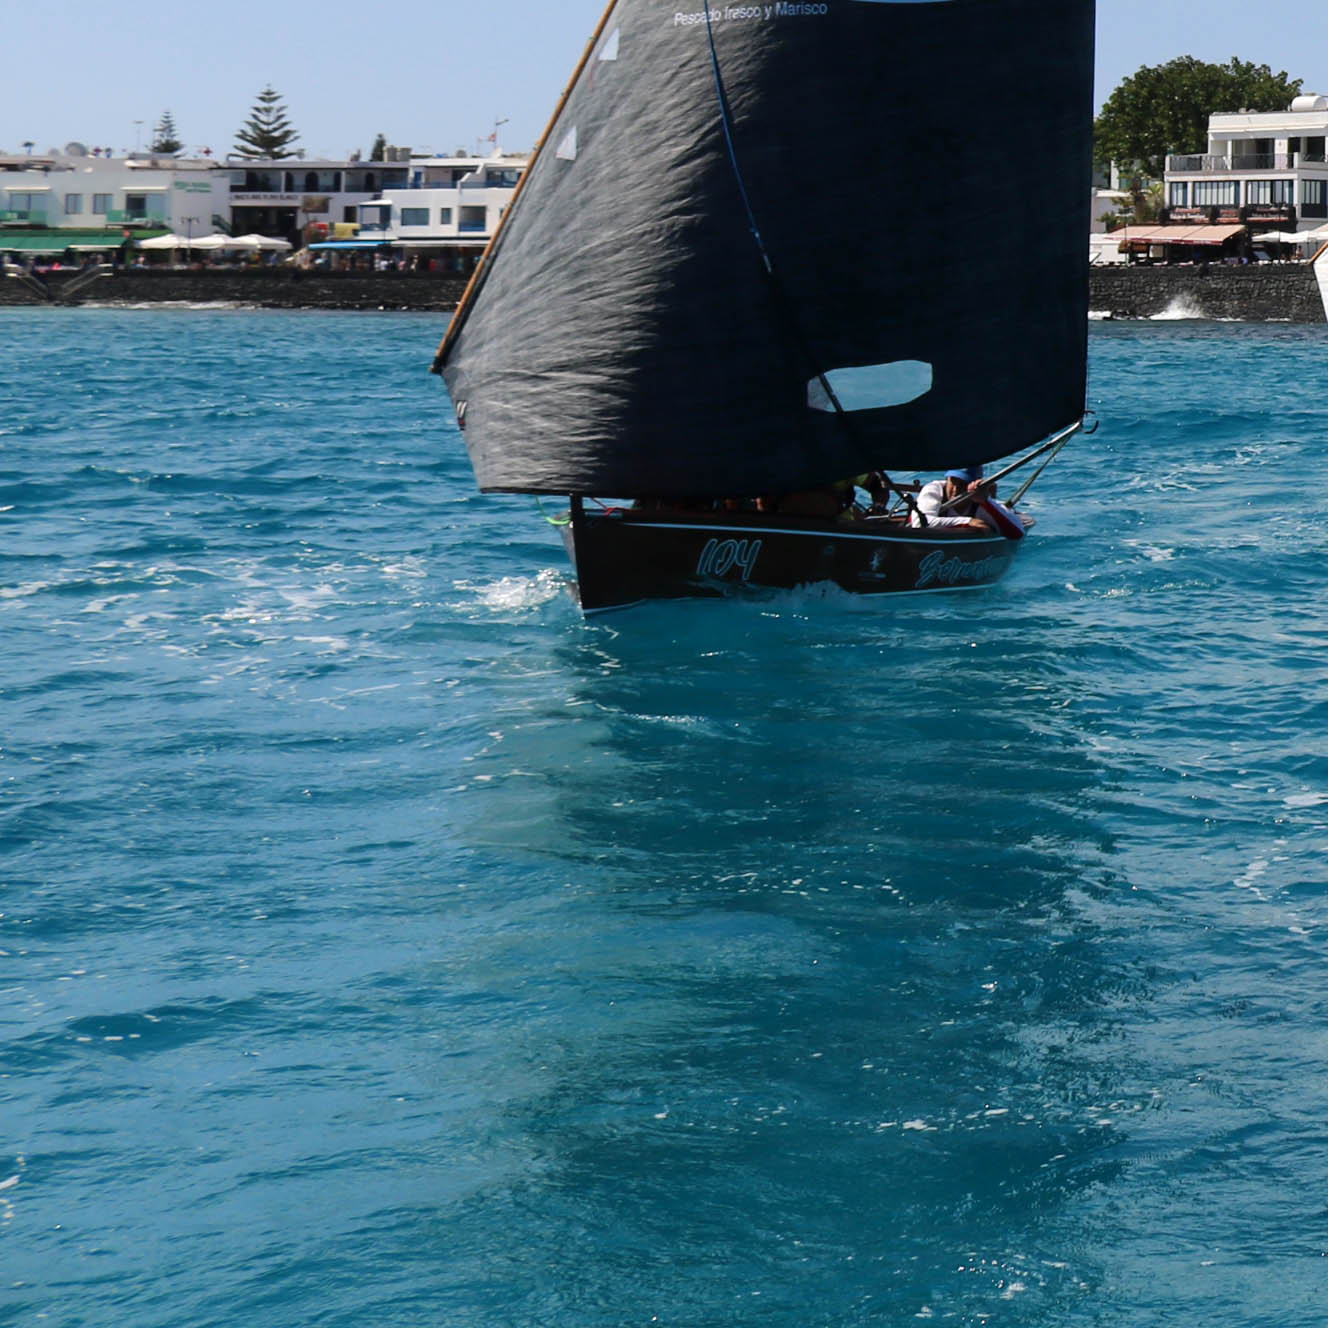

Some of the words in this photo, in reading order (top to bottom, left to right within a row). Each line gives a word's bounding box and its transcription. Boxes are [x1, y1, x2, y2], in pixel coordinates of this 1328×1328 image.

[674, 7, 721, 26] Pescado
[764, 5, 773, 20] y
[775, 1, 828, 17] Marisco
[696, 538, 762, 580] 104
